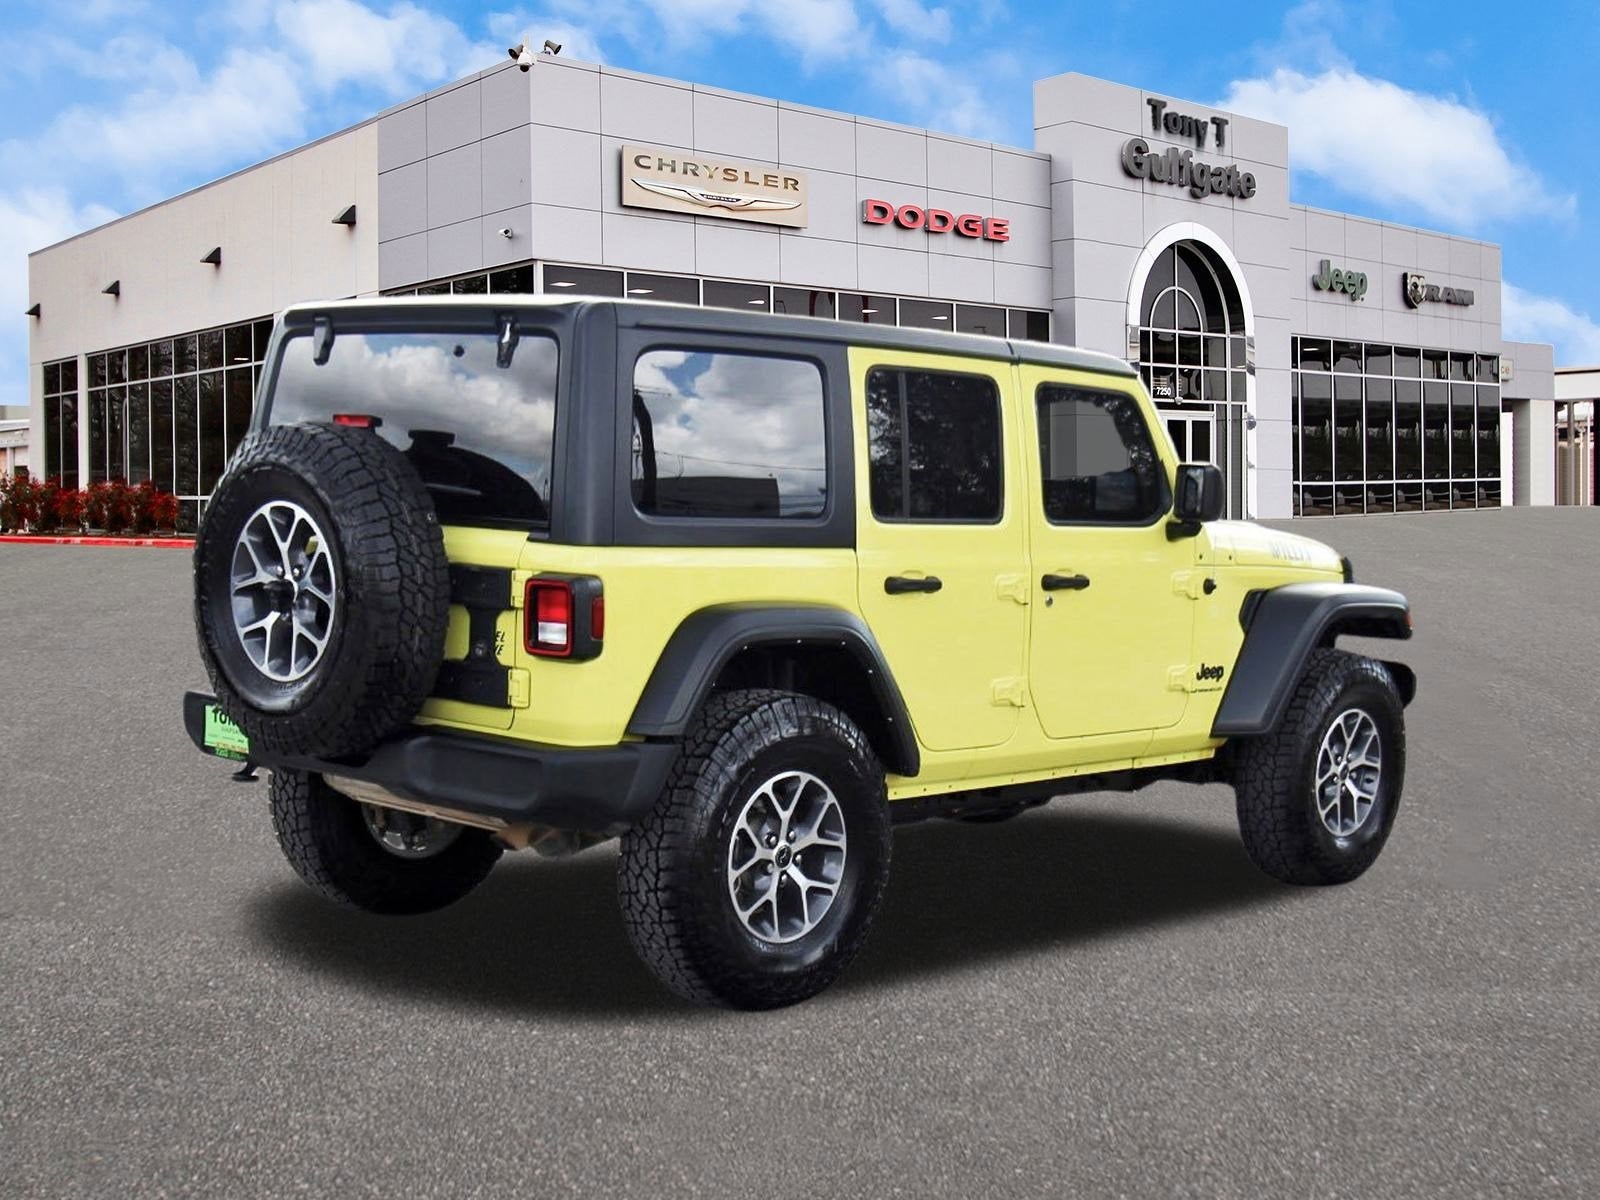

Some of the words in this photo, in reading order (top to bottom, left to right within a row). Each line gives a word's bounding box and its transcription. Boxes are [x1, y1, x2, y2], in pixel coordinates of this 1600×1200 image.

[1147, 98, 1208, 147] Tony
[1211, 117, 1229, 147] T
[634, 154, 800, 192] CHRYSLER
[1121, 138, 1256, 199] Gulfgate
[863, 199, 1010, 242] DODGE
[1312, 259, 1368, 301] Jeep
[1425, 284, 1474, 307] RAM
[1156, 386, 1172, 396] 7250
[1196, 662, 1224, 683] Jeep
